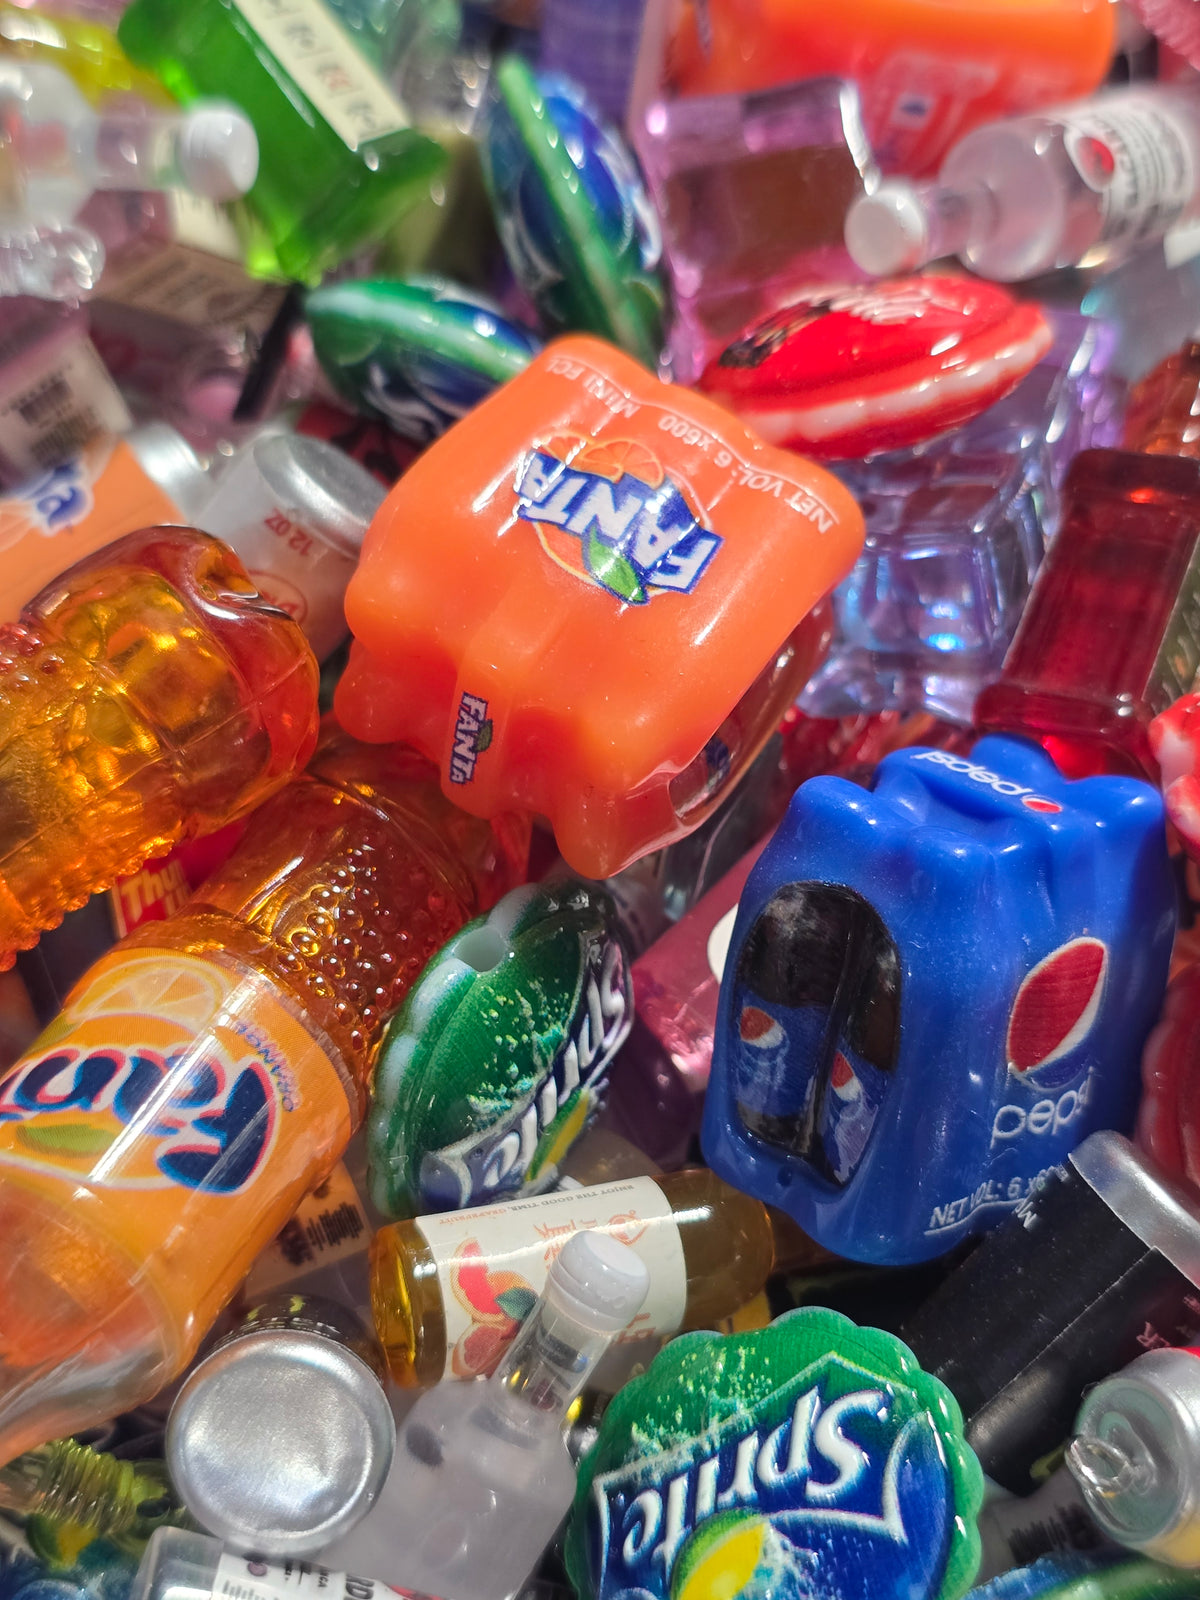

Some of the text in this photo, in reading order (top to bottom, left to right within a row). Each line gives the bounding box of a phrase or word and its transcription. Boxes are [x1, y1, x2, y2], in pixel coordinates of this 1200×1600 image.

[714, 450, 732, 468] 6
[516, 450, 724, 595] FANTA
[784, 490, 833, 534] NET
[289, 529, 313, 556] 12
[450, 692, 493, 785] FANTA
[911, 749, 1030, 799] pepsi
[541, 1194, 575, 1207] GOOD
[575, 1191, 599, 1202] THE
[930, 1197, 969, 1228] NET
[1007, 1176, 1022, 1199] 6
[622, 1385, 888, 1590] Sprite
